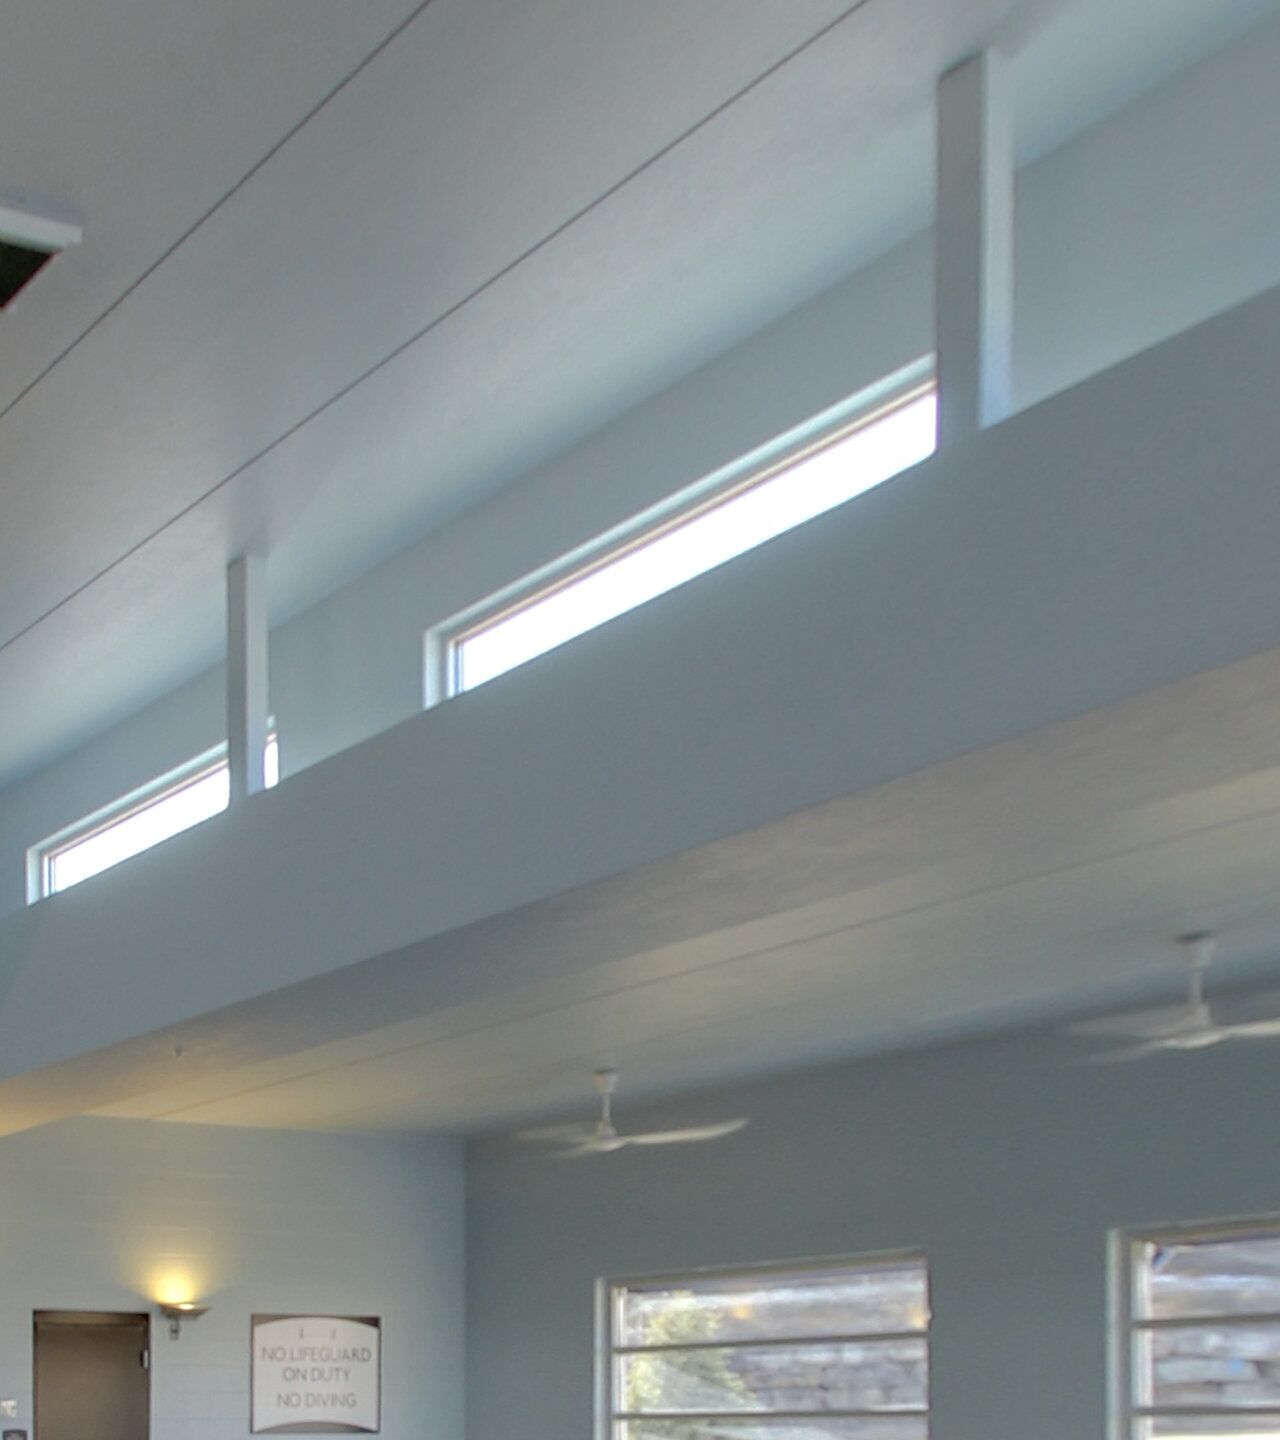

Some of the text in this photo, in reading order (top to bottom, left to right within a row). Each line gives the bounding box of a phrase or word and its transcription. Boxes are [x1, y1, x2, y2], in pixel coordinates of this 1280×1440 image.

[261, 1346, 372, 1364] NO LIFEGUARD
[282, 1367, 352, 1382] ON DUTY
[276, 1392, 358, 1409] NO DIVING
